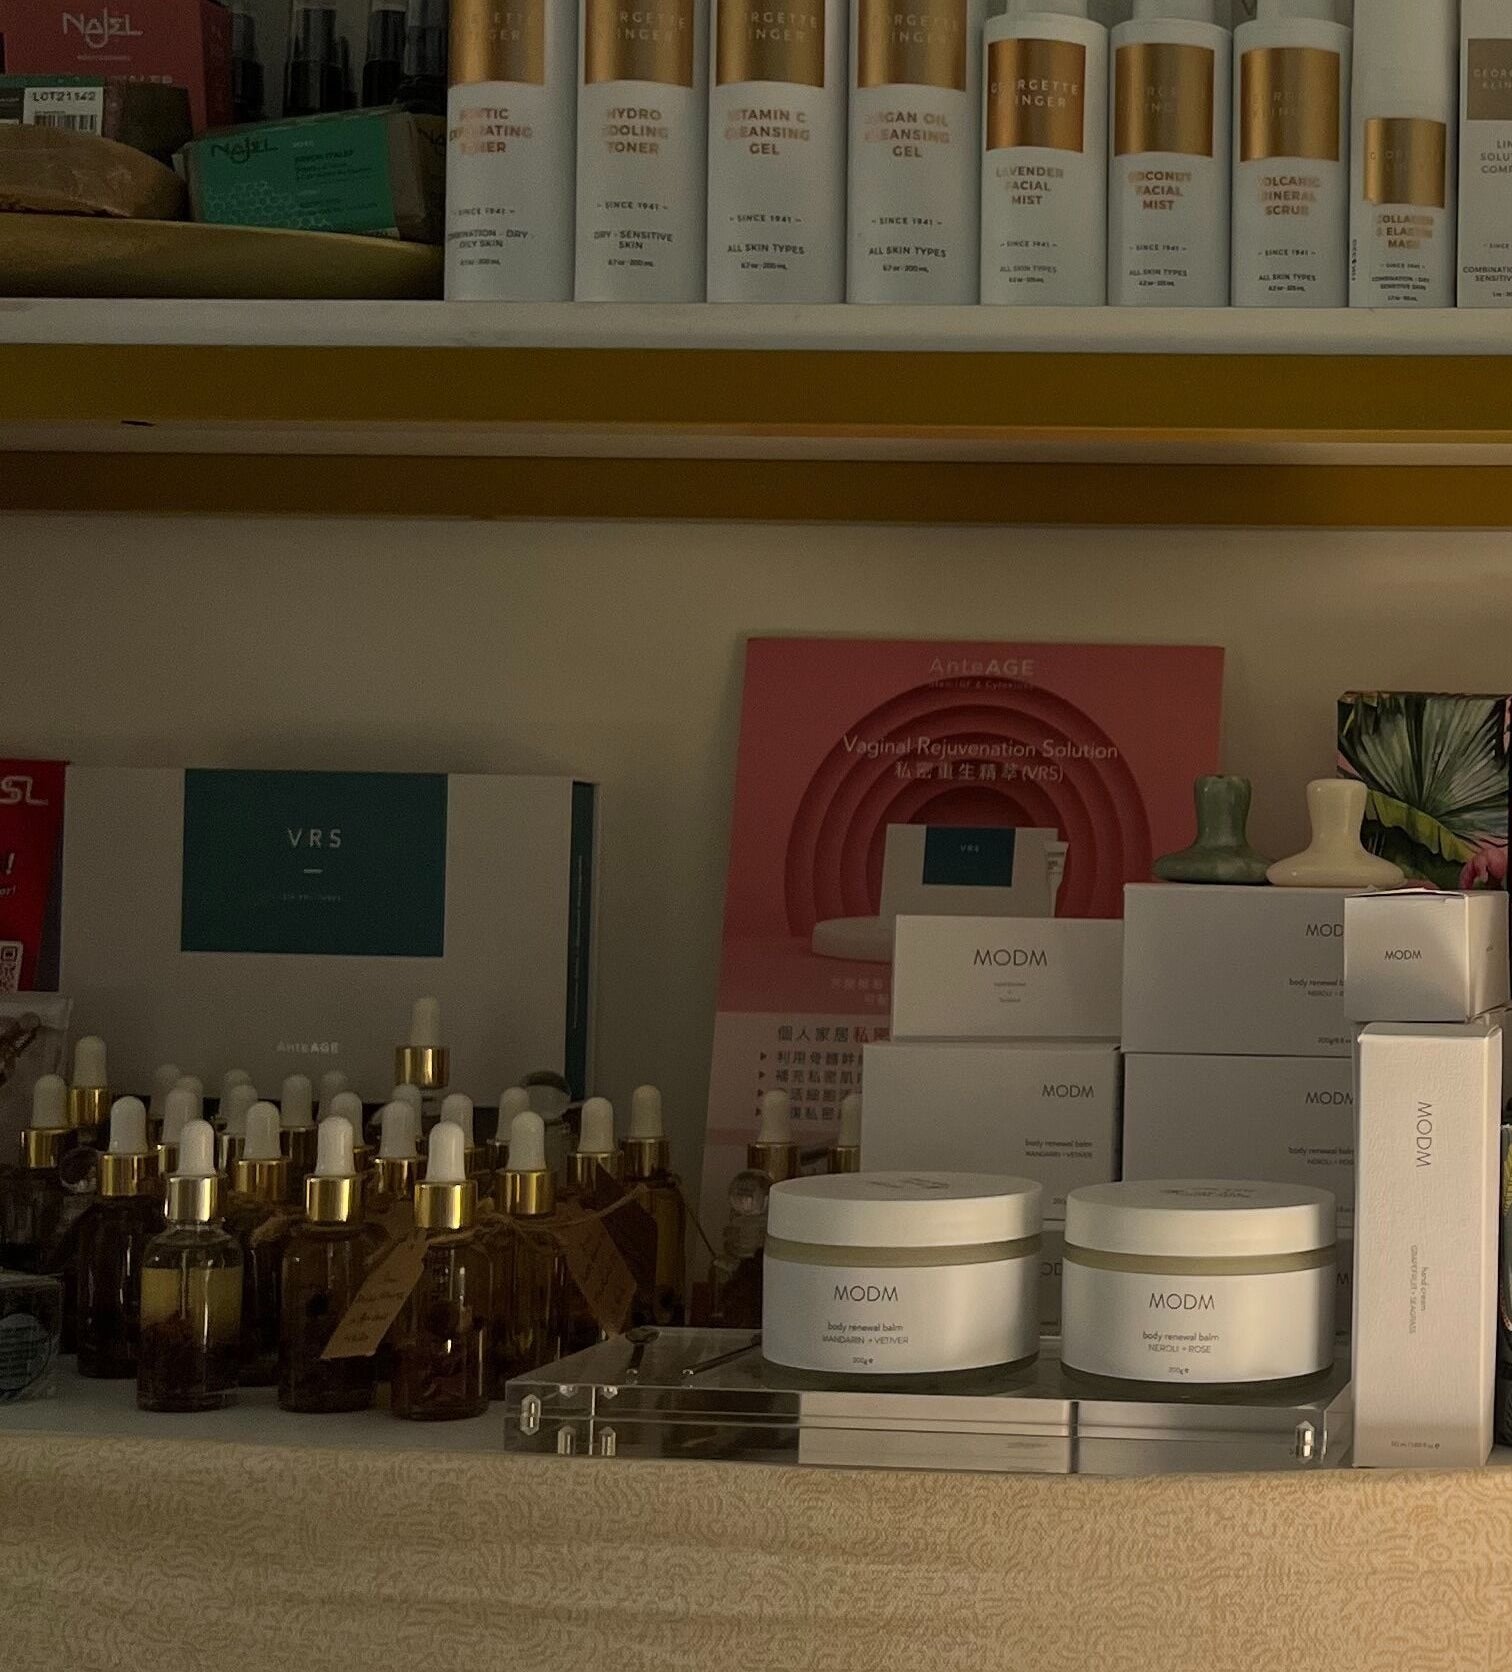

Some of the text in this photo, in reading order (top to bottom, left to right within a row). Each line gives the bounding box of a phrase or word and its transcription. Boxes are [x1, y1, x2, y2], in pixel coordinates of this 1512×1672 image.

[991, 79, 1078, 96] GRGETTE
[606, 107, 662, 121] HYDRO
[728, 109, 806, 123] TAMIN C
[725, 126, 810, 141] EANSING
[865, 129, 950, 144] EANSING
[750, 143, 780, 155] GEL
[892, 145, 923, 158] GEL
[1011, 195, 1043, 205] MIST
[1260, 190, 1317, 202] INERAL
[1143, 200, 1175, 211] MIST
[745, 244, 805, 255] SKIN TYPES
[886, 246, 910, 254] SKIN
[914, 246, 947, 258] TYPES
[928, 658, 1035, 676] AnteAGE
[843, 735, 1118, 760] Vaginal Rejuvenation Solution
[287, 828, 342, 848] VRS
[1306, 923, 1344, 937] MOD
[973, 948, 1047, 966] MODM
[1384, 949, 1422, 960] MODM
[1042, 1084, 1095, 1098] MODM
[1416, 1101, 1432, 1168] MODM
[833, 1285, 898, 1302] MODM
[1149, 1293, 1215, 1310] MODM
[828, 1322, 904, 1333] body renewal balm
[874, 1336, 909, 1344] VETIVER
[1142, 1331, 1219, 1342] body renewal balm
[1188, 1345, 1211, 1354] ROSE
